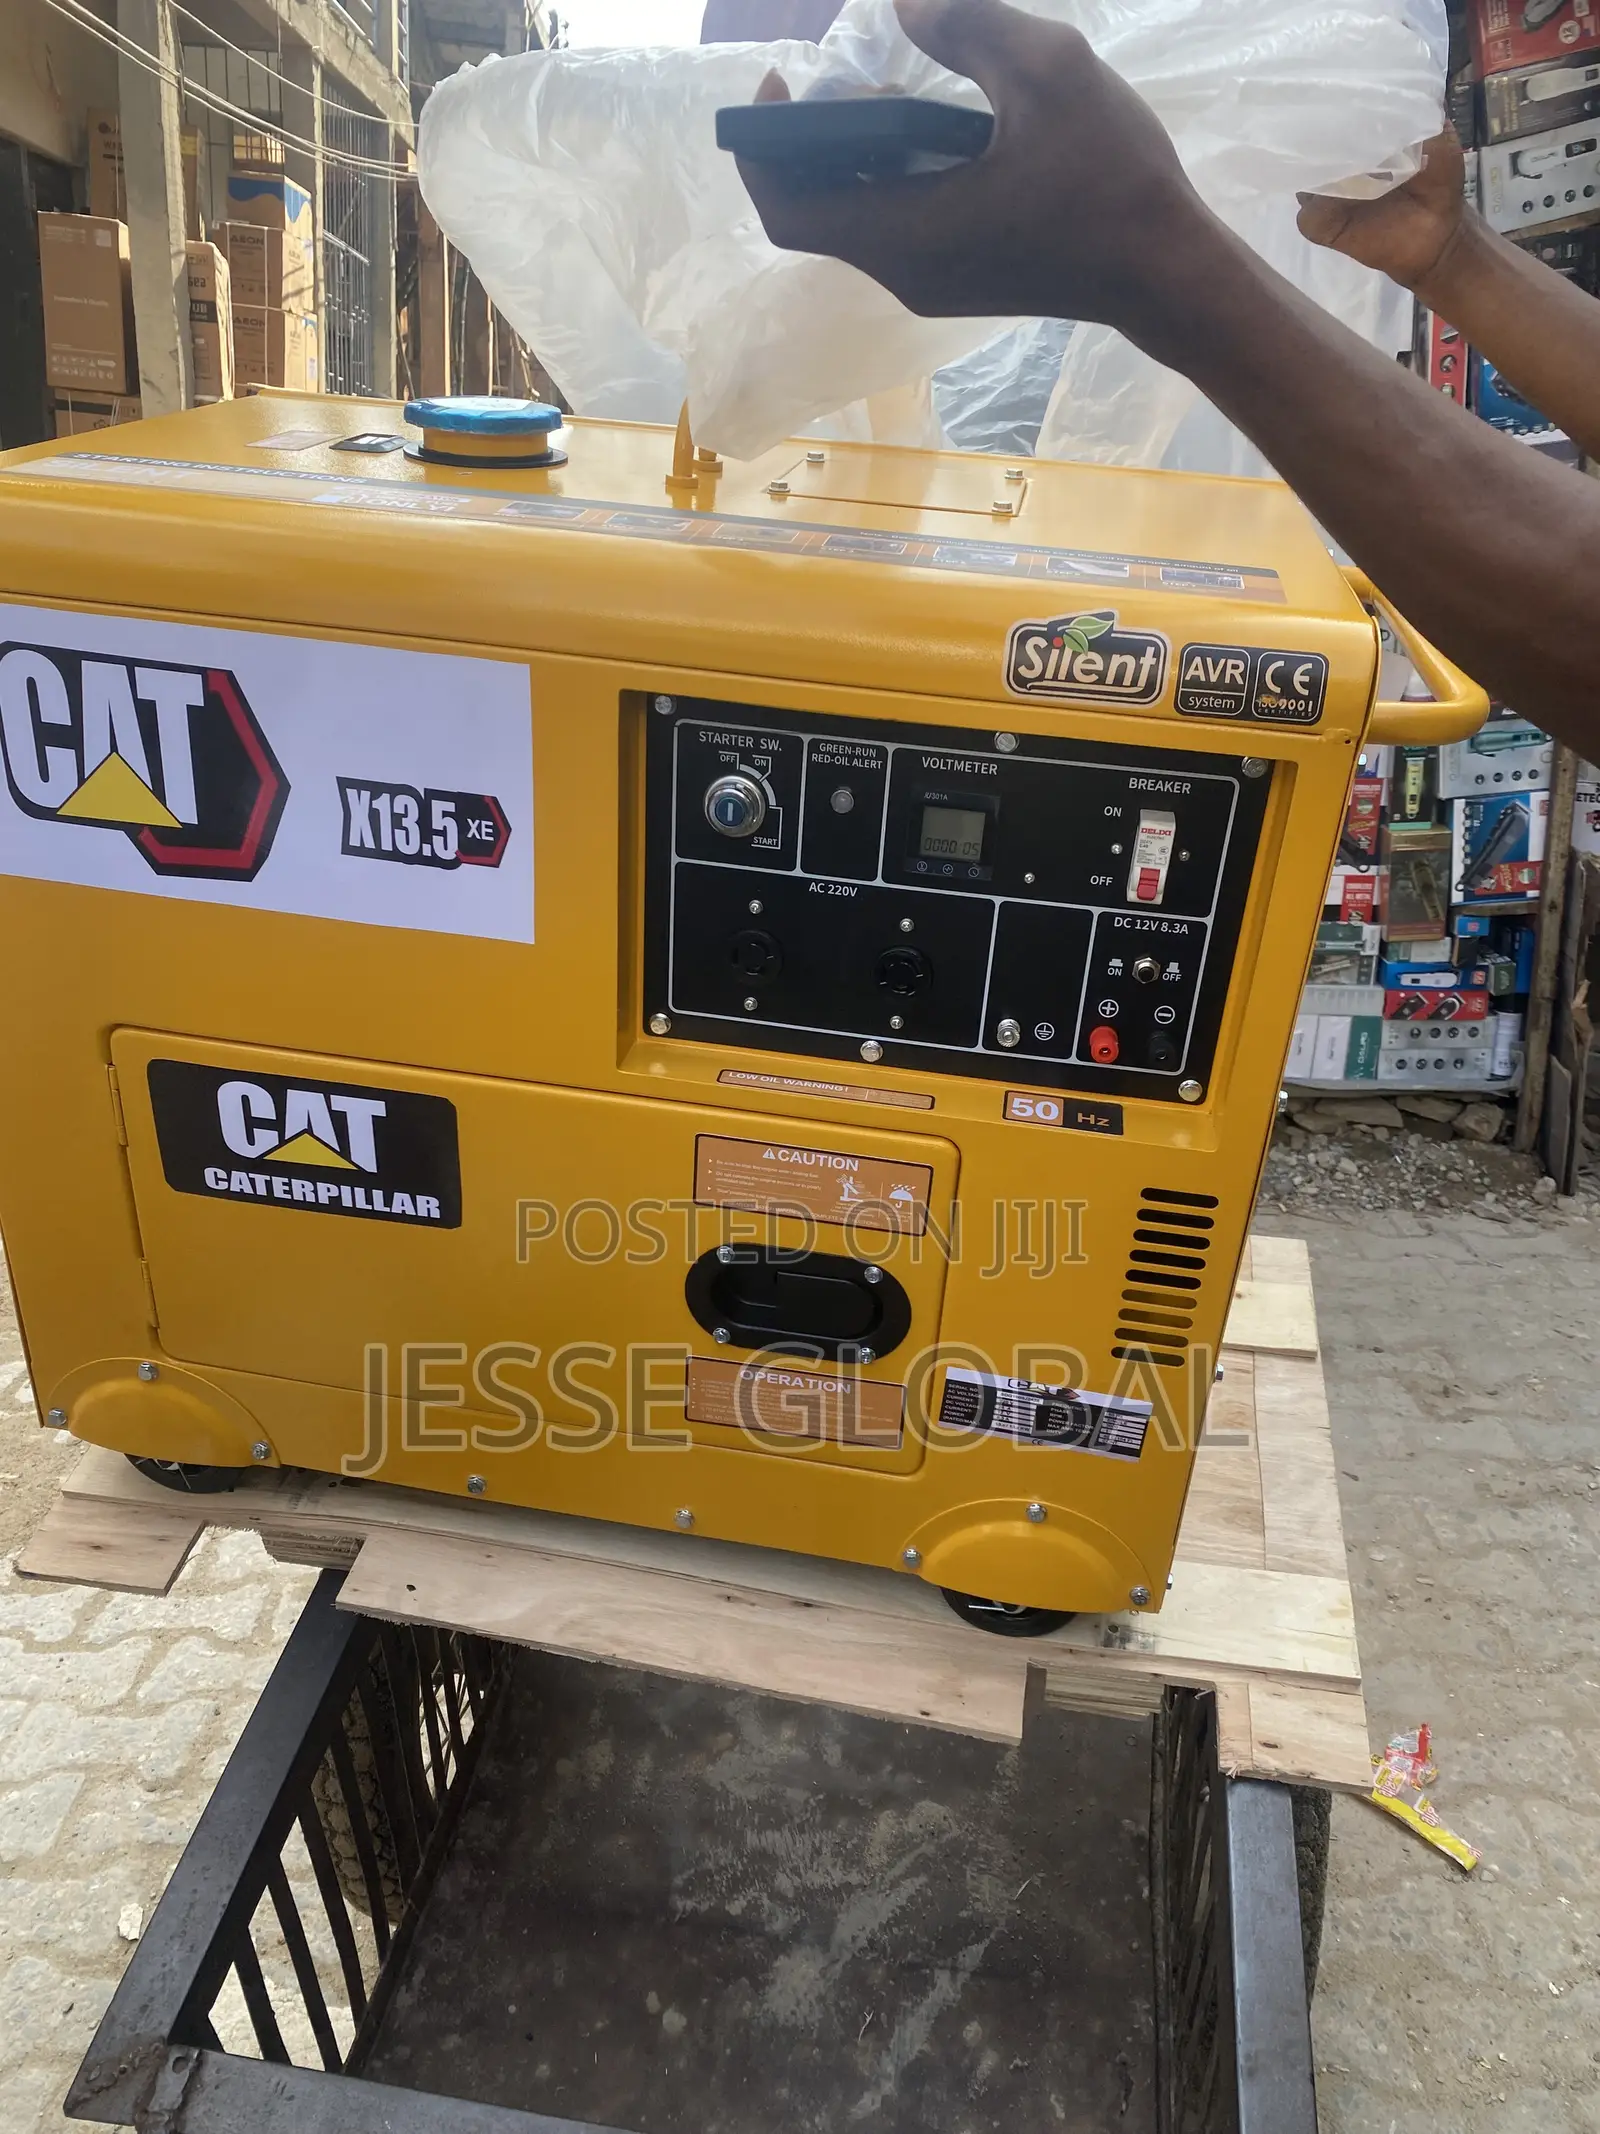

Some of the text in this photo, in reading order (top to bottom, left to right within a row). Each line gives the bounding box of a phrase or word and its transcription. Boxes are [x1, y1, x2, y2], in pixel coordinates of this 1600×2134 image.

[43, 458, 203, 479] SILENT
[73, 452, 367, 484] STARTING INSTRUCTIONS
[1017, 635, 1157, 687] Silent
[1184, 656, 1245, 685] AVR
[1265, 660, 1313, 696] CE
[1188, 695, 1235, 709] system
[0, 647, 205, 827] CAT
[699, 731, 782, 752] STARTER SW.
[720, 754, 736, 764] OFF
[819, 743, 877, 758] GREEN-RUN
[754, 758, 767, 767] ON
[811, 753, 883, 770] RED-OIL ALERT
[921, 756, 998, 776] VOLTMETER
[1128, 777, 1192, 795] BREAKER
[1104, 806, 1122, 817] ON
[343, 786, 495, 861] X13.5 XE
[1141, 827, 1172, 836] DELIXI
[753, 836, 778, 847] START
[809, 881, 858, 897] AC 220V
[1090, 875, 1113, 886] OFF
[1114, 916, 1189, 935] DC 12V 8.3A
[1107, 967, 1122, 977] ON
[1162, 972, 1182, 982] OFF
[728, 1071, 849, 1093] LOW OIL WARNING!
[1011, 1097, 1110, 1127] 50 Hz
[216, 1080, 387, 1174] CAT
[778, 1149, 859, 1172] CAUTION
[204, 1166, 441, 1219] CATERPILLAR
[740, 1369, 851, 1394] OPERATION
